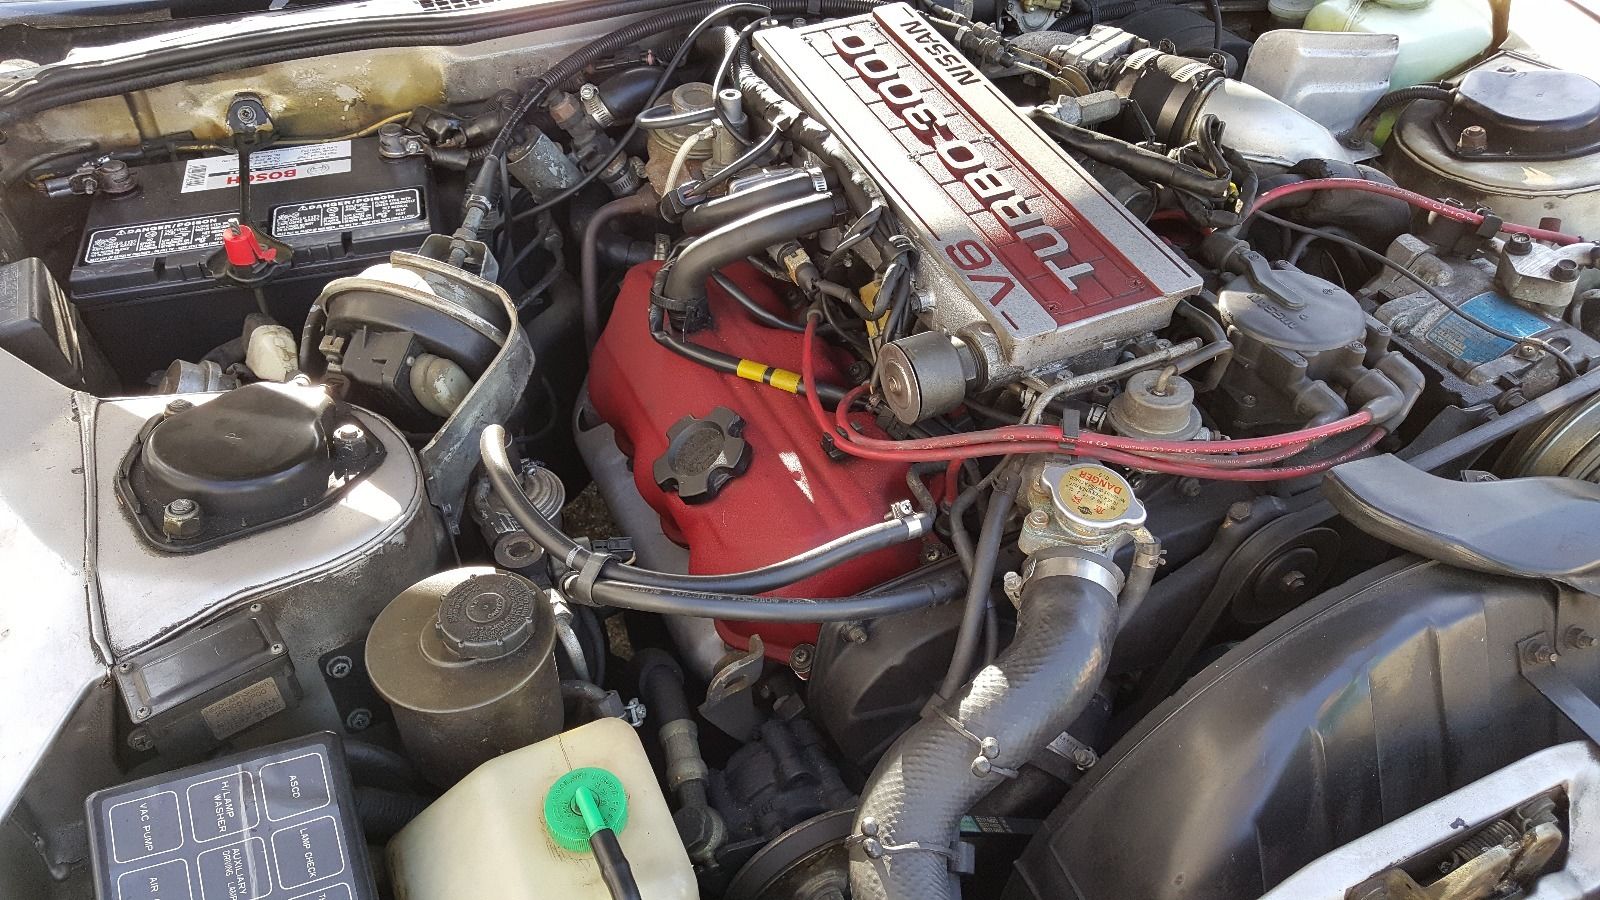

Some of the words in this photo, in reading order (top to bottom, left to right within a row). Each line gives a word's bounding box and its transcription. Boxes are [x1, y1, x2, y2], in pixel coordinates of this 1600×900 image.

[900, 20, 981, 86] NISSAN
[832, 25, 949, 131] 3000
[936, 138, 1096, 293] TURBO
[944, 239, 1016, 307] V6
[1078, 470, 1123, 495] DANGER
[139, 803, 149, 822] VAC
[213, 794, 227, 833] WASHER
[221, 781, 235, 818] H/LAMP
[142, 825, 153, 851] PUMP
[299, 828, 311, 849] LAMP
[231, 848, 248, 895] AUXILIARY
[304, 851, 317, 879] CHECK
[148, 877, 159, 893] AIR
